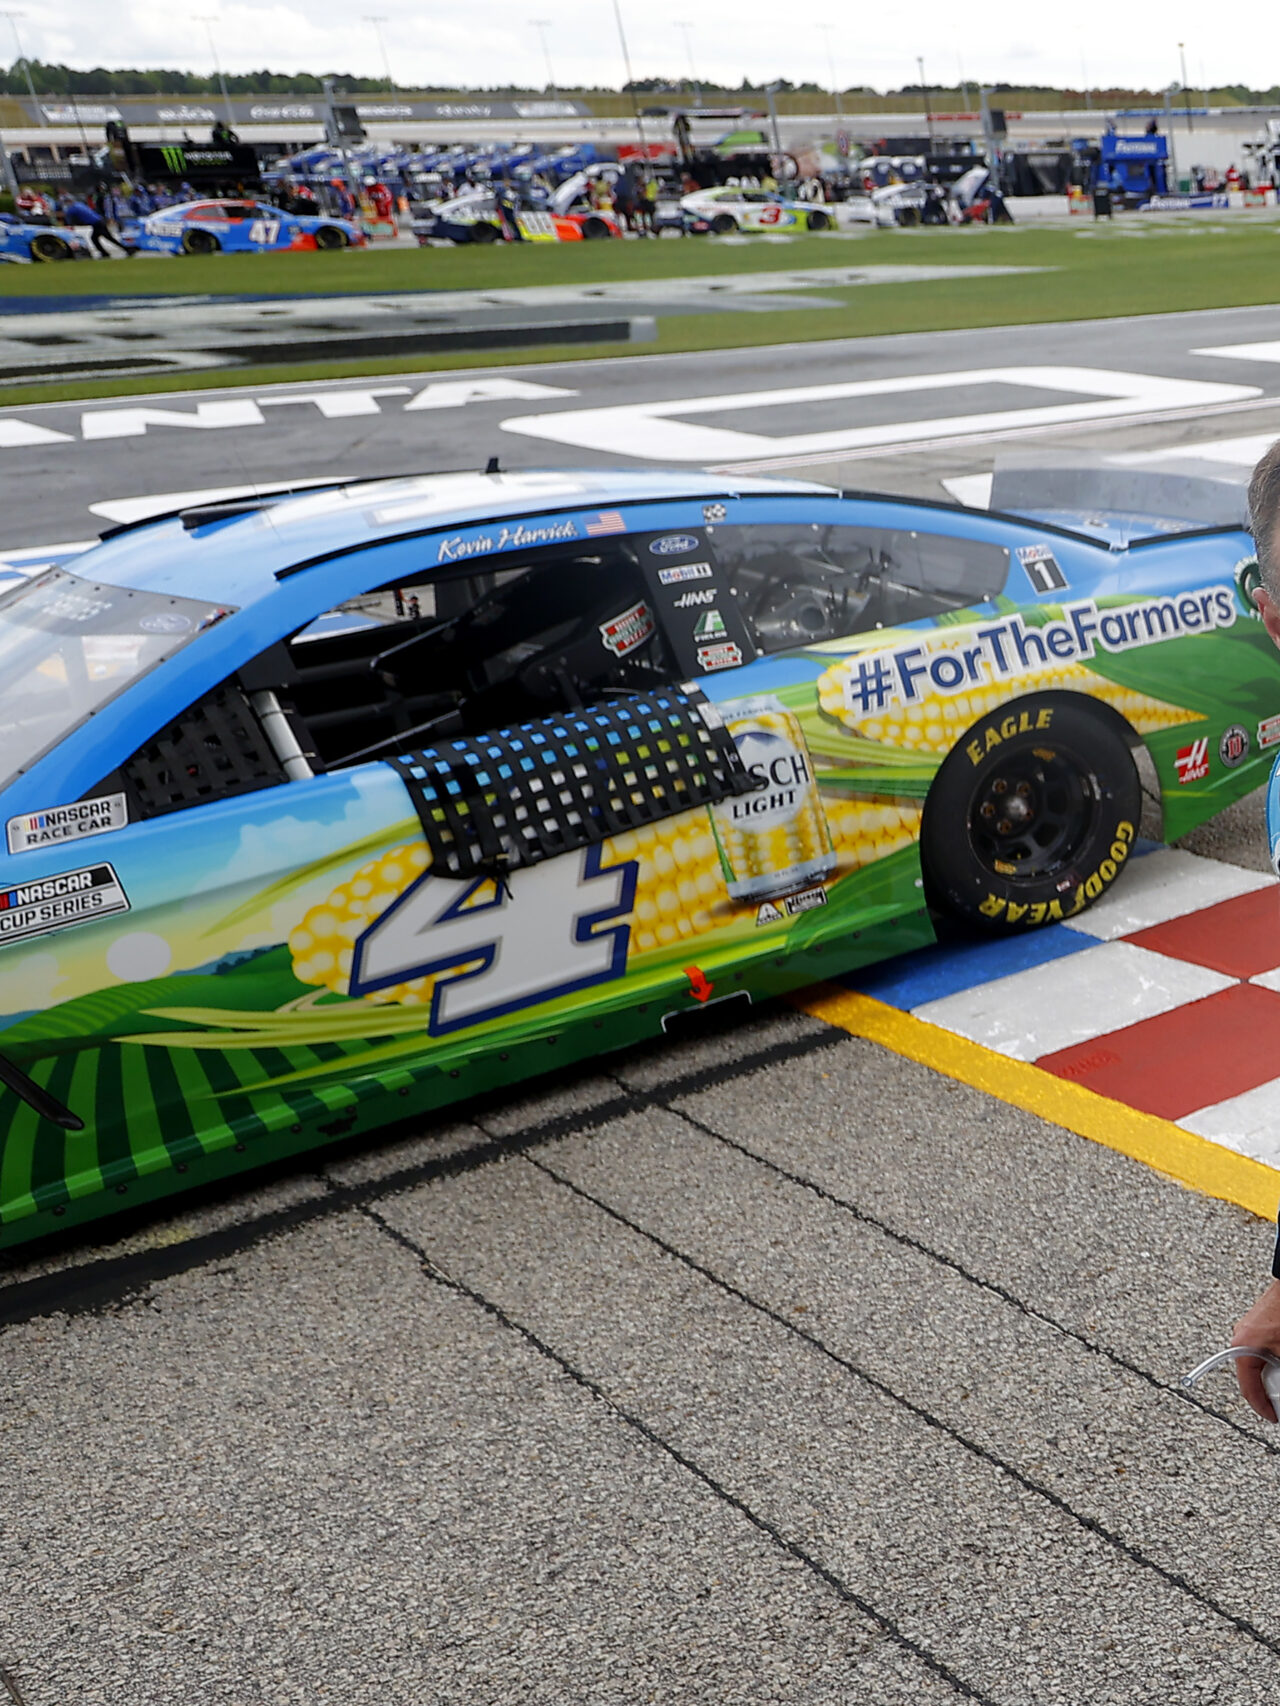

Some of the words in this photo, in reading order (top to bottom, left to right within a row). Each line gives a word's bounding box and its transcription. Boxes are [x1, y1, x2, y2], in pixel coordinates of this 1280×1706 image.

[249, 220, 281, 244] 47
[759, 206, 781, 225] 3
[437, 538, 494, 563] Kevin
[499, 520, 578, 550] Harvick
[850, 588, 1234, 711] #ForTheFarmers
[965, 708, 1054, 767] EAGLE
[747, 753, 810, 793] SCH
[45, 800, 111, 827] NASCAR
[732, 789, 796, 820] LIGHT
[26, 825, 72, 844] RACE
[78, 816, 111, 833] CAR
[17, 871, 93, 906] NASCAR
[978, 820, 1134, 926] GOODYEAR
[0, 911, 36, 932] CUP
[40, 893, 103, 921] SERIES
[348, 842, 640, 1037] 4
